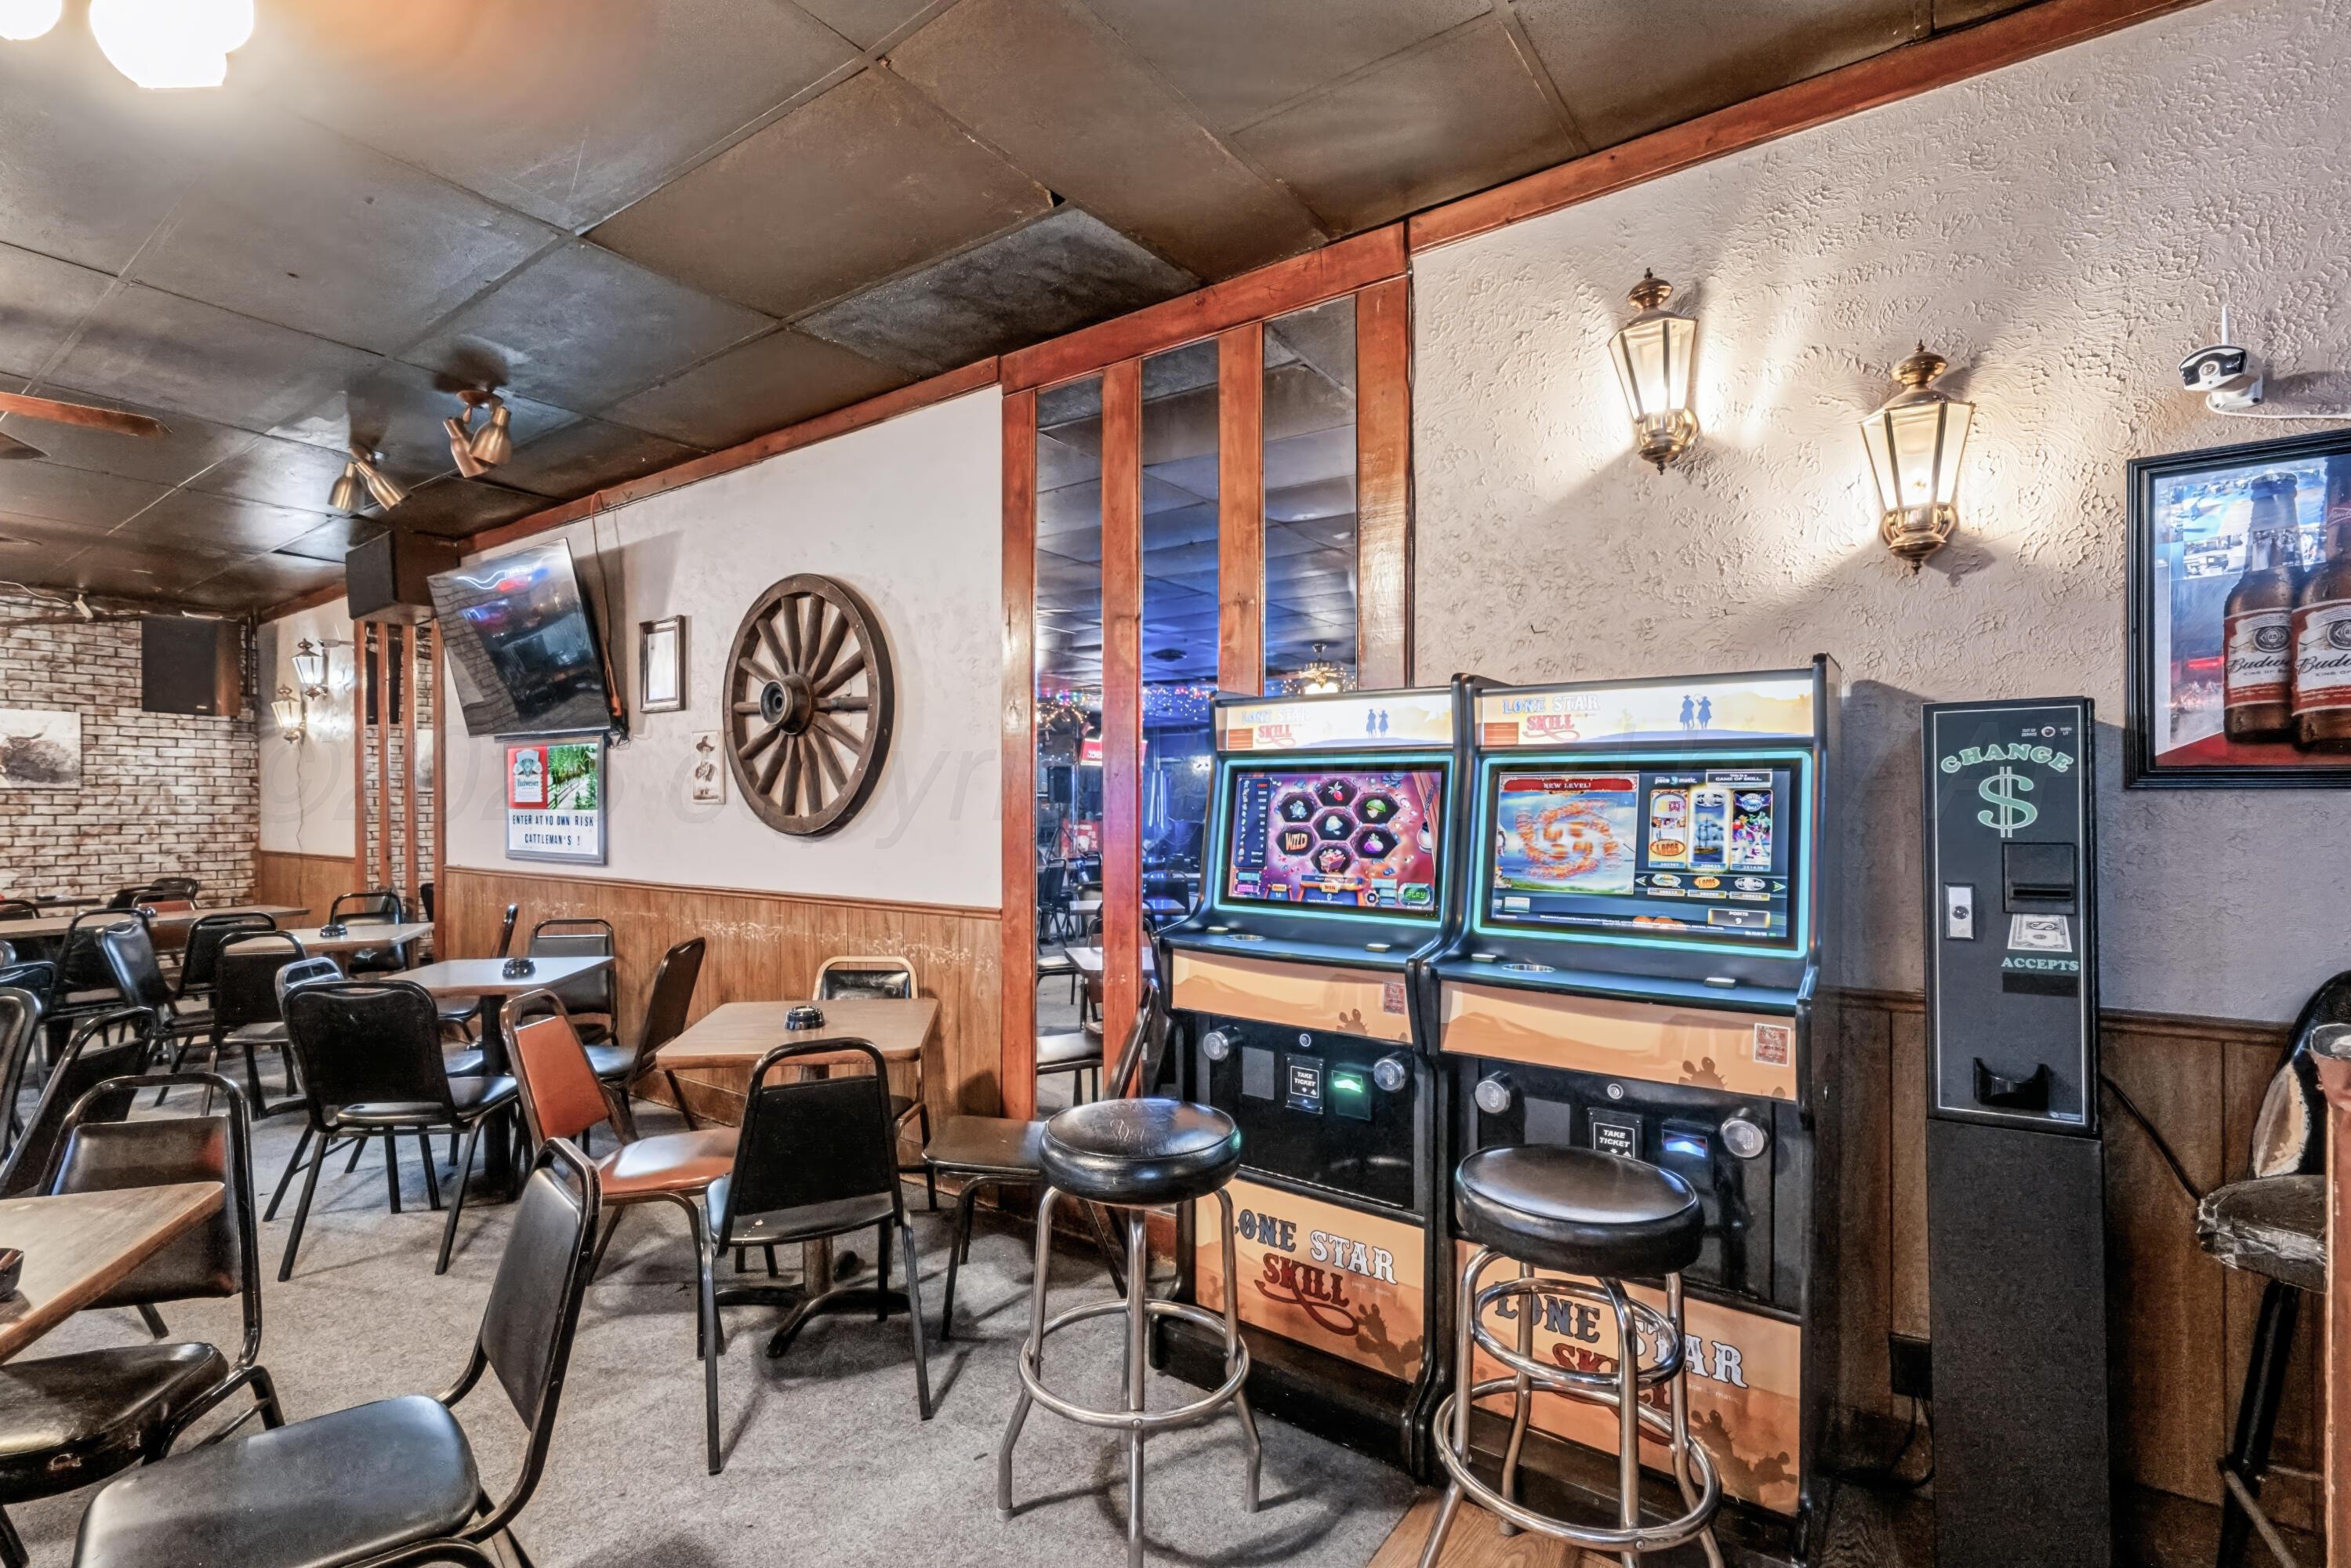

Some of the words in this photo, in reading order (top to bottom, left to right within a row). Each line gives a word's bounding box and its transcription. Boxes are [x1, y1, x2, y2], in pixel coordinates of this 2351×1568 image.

[1501, 697, 1546, 715] LONE
[1554, 694, 1600, 712] STAR
[1526, 713, 1576, 731] SKILL
[1257, 723, 1294, 739] SKILL
[1940, 743, 2074, 773] CHANGE
[517, 778, 539, 788] Budweiser
[513, 815, 532, 825] ENTER
[535, 815, 543, 825] AT
[546, 815, 553, 826] YO
[557, 815, 570, 826] OWN
[575, 815, 594, 827] RISK
[524, 833, 571, 846] CATTLEMAN'S
[1285, 832, 1308, 851] WILD
[2001, 956, 2080, 971] ACCEPTS
[1294, 1077, 1317, 1087] TICKET
[1297, 1071, 1314, 1080] TAKE
[1603, 1129, 1627, 1139] TAKE
[1599, 1137, 1631, 1148] TICKET
[1234, 1208, 1297, 1253] ONE
[1309, 1229, 1399, 1286] STAR
[1262, 1252, 1351, 1308] SKILL
